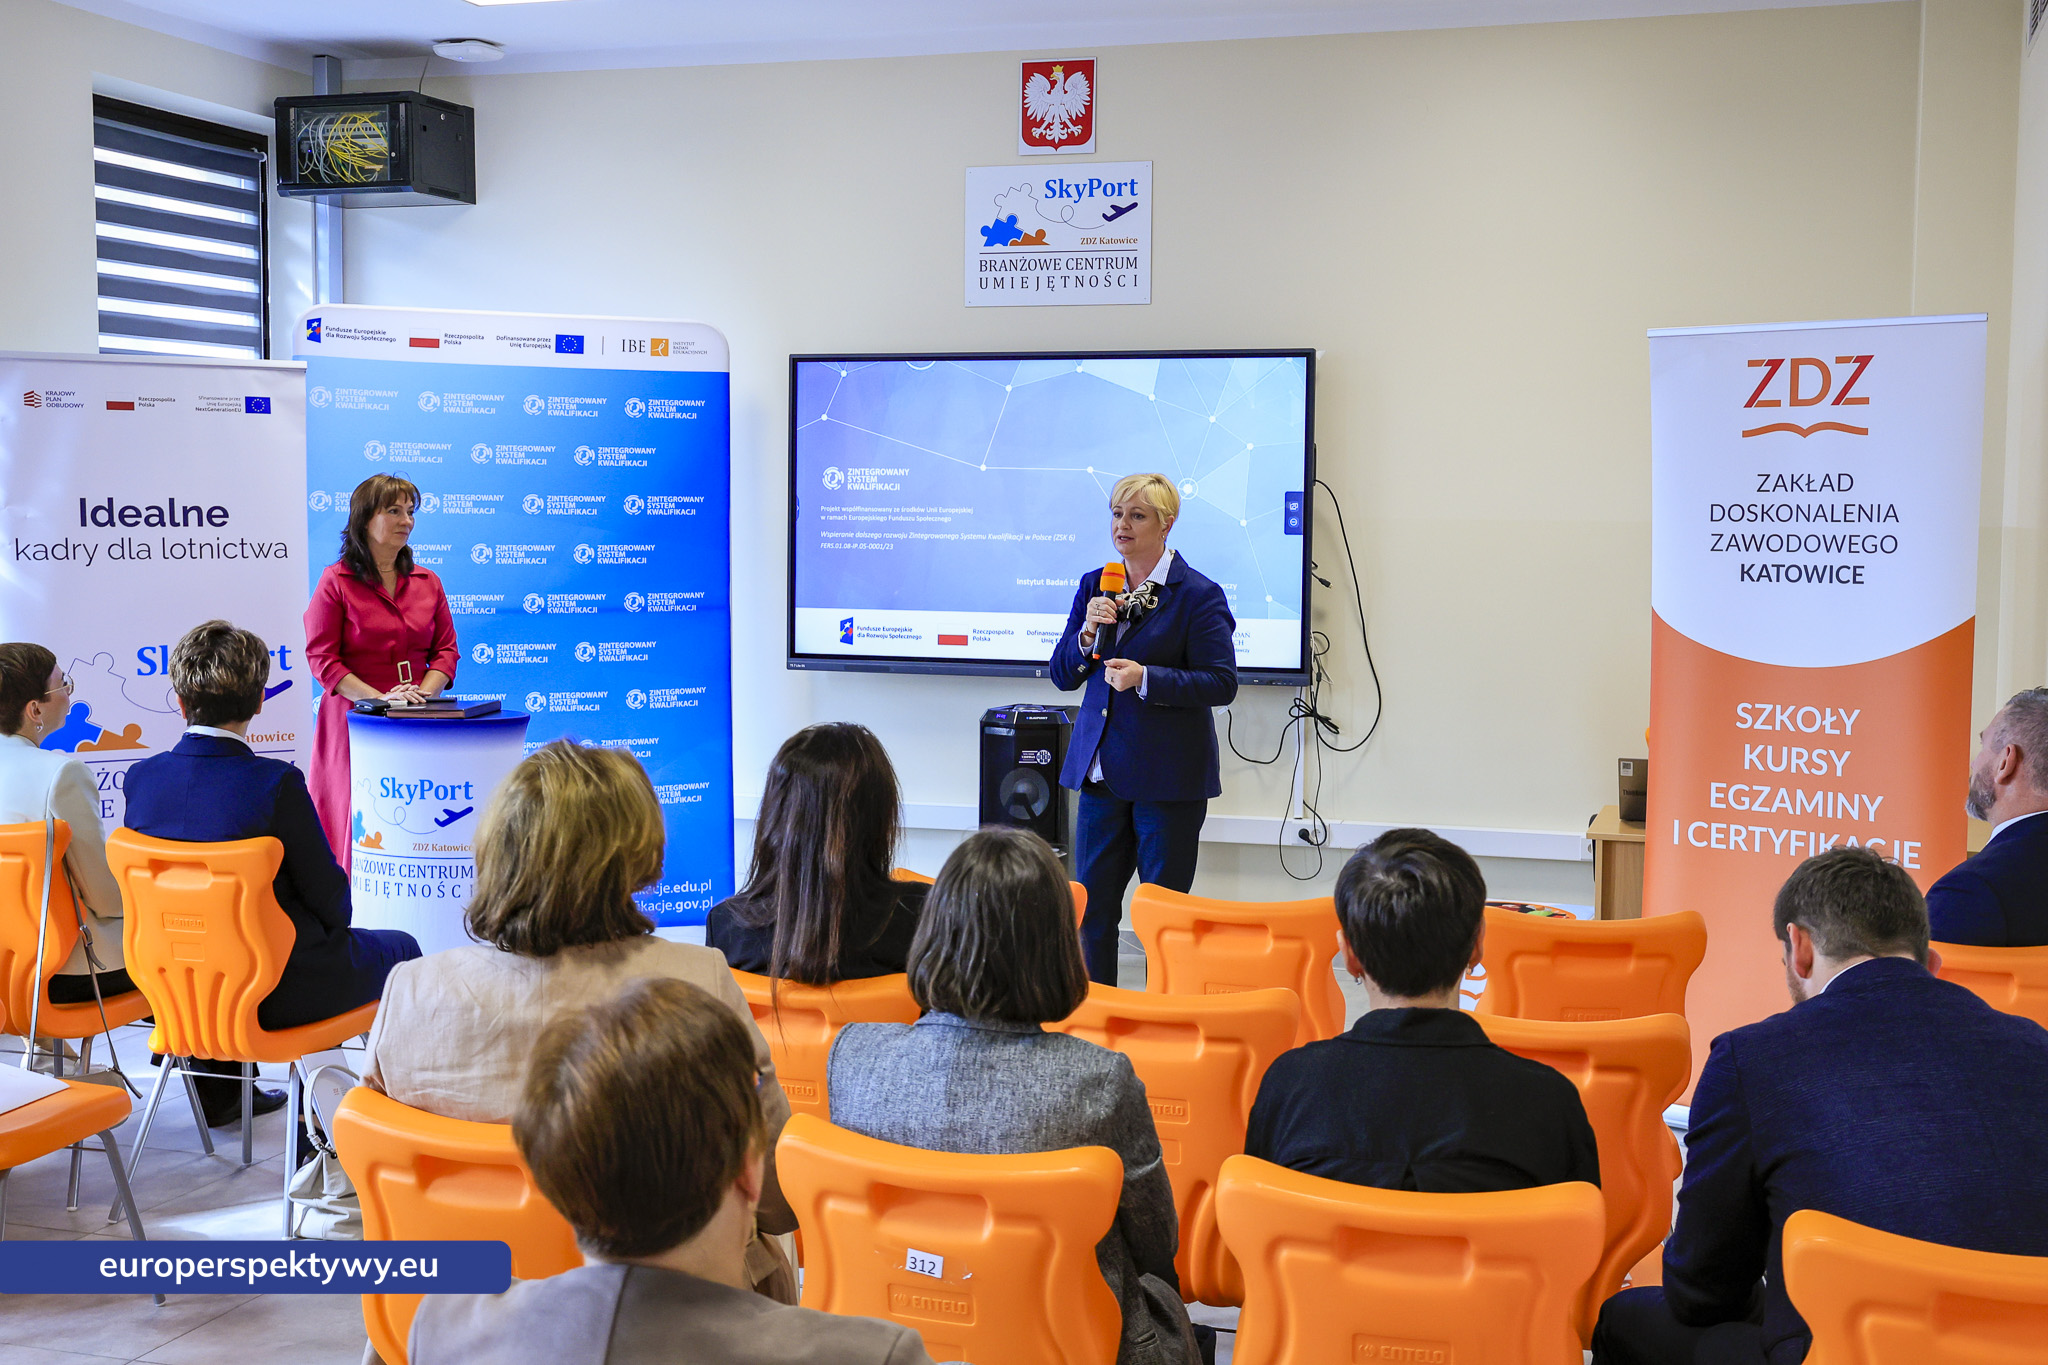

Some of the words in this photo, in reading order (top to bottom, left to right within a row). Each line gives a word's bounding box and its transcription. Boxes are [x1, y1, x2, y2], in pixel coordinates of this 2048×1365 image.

[1044, 177, 1139, 204] SkyPort
[1080, 237, 1097, 246] ZDZ
[1099, 236, 1139, 245] Katowice
[979, 256, 1062, 273] BRANŻOWE
[1065, 256, 1138, 271] CENTRUM
[979, 272, 1138, 292] UMIEJĘTNOŚCI
[360, 335, 397, 343] Społecznego
[622, 339, 646, 353] IBE
[1743, 354, 1875, 409] ZDZ
[334, 388, 399, 398] ZINTEGROWANY
[443, 393, 505, 401] ZINTEGROWANY
[335, 395, 367, 403] SYSTEM
[547, 396, 608, 405] ZINTEGROWANY
[648, 399, 706, 407] ZINTEGROWANY
[335, 401, 390, 411] KWALIFIKACJI
[443, 406, 496, 415] KWALIFIKACJI
[648, 405, 677, 413] SYSTEM
[547, 410, 598, 418] KWALIFIKACJI
[648, 412, 697, 420] KWALIFIKACJI
[389, 442, 452, 451] ZINTEGROWANY
[495, 444, 556, 453] ZINTEGROWANY
[598, 446, 657, 455] ZINTEGROWANY
[389, 448, 421, 456] SYSTEM
[495, 451, 526, 459] SYSTEM
[389, 455, 443, 464] KWALIFIKACJI
[495, 457, 547, 466] KWALIFIKACJI
[847, 468, 910, 476] ZINTEGROWANY
[847, 475, 878, 483] SYSTEM
[1756, 473, 1855, 493] ZAKŁAD
[847, 483, 900, 491] KWALIFIKACJI
[442, 493, 504, 502] ZINTEGROWANY
[547, 495, 606, 503] ZINTEGROWANY
[647, 495, 705, 503] ZINTEGROWANY
[442, 500, 473, 508] SYSTEM
[547, 501, 576, 509] SYSTEM
[80, 497, 229, 528] Idealne
[442, 507, 496, 515] KWALIFIKACJI
[547, 508, 598, 516] KWALIFIKACJI
[647, 508, 696, 516] KWALIFIKACJI
[820, 505, 841, 513] Projekt
[841, 505, 893, 514] współfinansowany
[939, 506, 974, 515] Europejskiej
[1709, 503, 1900, 523] DOSKONALENIA
[848, 514, 888, 522] Europejskiego
[916, 515, 952, 523] Społecznego
[820, 531, 855, 539] Wspieranie
[855, 531, 882, 540] dalszego
[883, 532, 908, 540] rozwoju
[908, 532, 960, 540] Zintegrowanego
[960, 533, 987, 541] Systemu
[988, 533, 1024, 542] Kwalifikacji
[1053, 533, 1067, 542] (ZSK
[1068, 534, 1076, 542] 6)
[1710, 532, 1899, 554] ZAWODOWEGO
[15, 538, 98, 567] kadry
[108, 537, 152, 560] dla
[162, 537, 289, 560] lotnictwa
[495, 544, 555, 552] ZINTEGROWANY
[597, 544, 656, 552] ZINTEGROWANY
[597, 557, 647, 565] KWALIFIKACJI
[1740, 563, 1865, 585] KATOWICE
[1016, 578, 1045, 587] Instytut
[1045, 578, 1068, 586] Badań
[547, 593, 606, 601] ZINTEGROWANY
[647, 592, 705, 600] ZINTEGROWANY
[647, 598, 676, 606] SYSTEM
[647, 604, 697, 613] KWALIFIKACJI
[496, 643, 557, 651] ZINTEGROWANY
[598, 641, 657, 650] ZINTEGROWANY
[598, 648, 628, 656] SYSTEM
[496, 656, 549, 664] KWALIFIKACJI
[598, 654, 649, 662] KWALIFIKACJI
[549, 691, 608, 700] ZINTEGROWANY
[649, 686, 707, 696] ZINTEGROWANY
[549, 698, 579, 706] SYSTEM
[649, 694, 678, 702] SYSTEM
[549, 704, 600, 713] KWALIFIKACJI
[649, 700, 698, 709] KWALIFIKACJI
[1735, 702, 1861, 736] SZKOŁY
[601, 738, 659, 746] ZINTEGROWANY
[1744, 743, 1851, 777] KURSY
[380, 777, 474, 806] SkyPort
[659, 795, 702, 805] WALIFIKACJI
[1710, 782, 1884, 823] EGZAMINY
[1672, 819, 1679, 845] I
[412, 843, 430, 851] ZDZ
[398, 863, 473, 879] CENTRUM
[352, 875, 473, 899] MIEJĘTNOŚCI
[908, 1256, 937, 1275] 312
